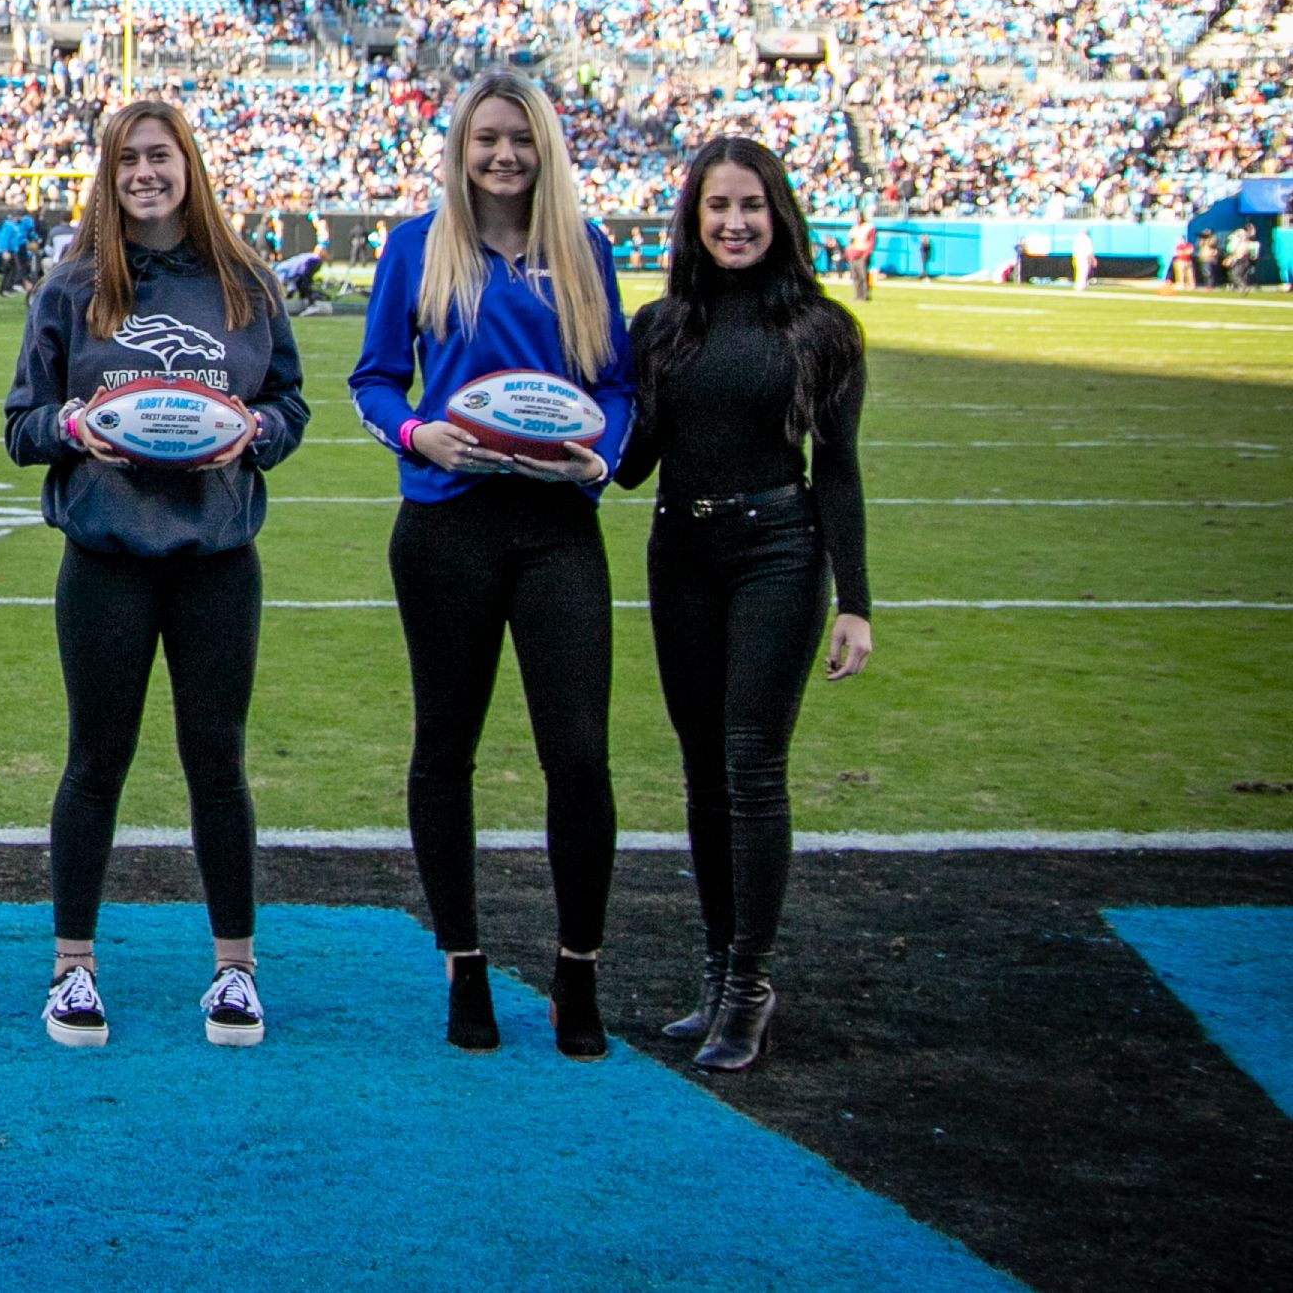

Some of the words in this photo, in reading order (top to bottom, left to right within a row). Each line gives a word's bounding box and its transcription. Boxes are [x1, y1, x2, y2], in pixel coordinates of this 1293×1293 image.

[504, 381, 543, 392] MAYCE
[135, 397, 164, 410] ABBY
[165, 397, 208, 412] RAMSEY
[178, 414, 201, 422] SCHOOL
[523, 418, 556, 433] 2019
[153, 440, 187, 452] 2019
